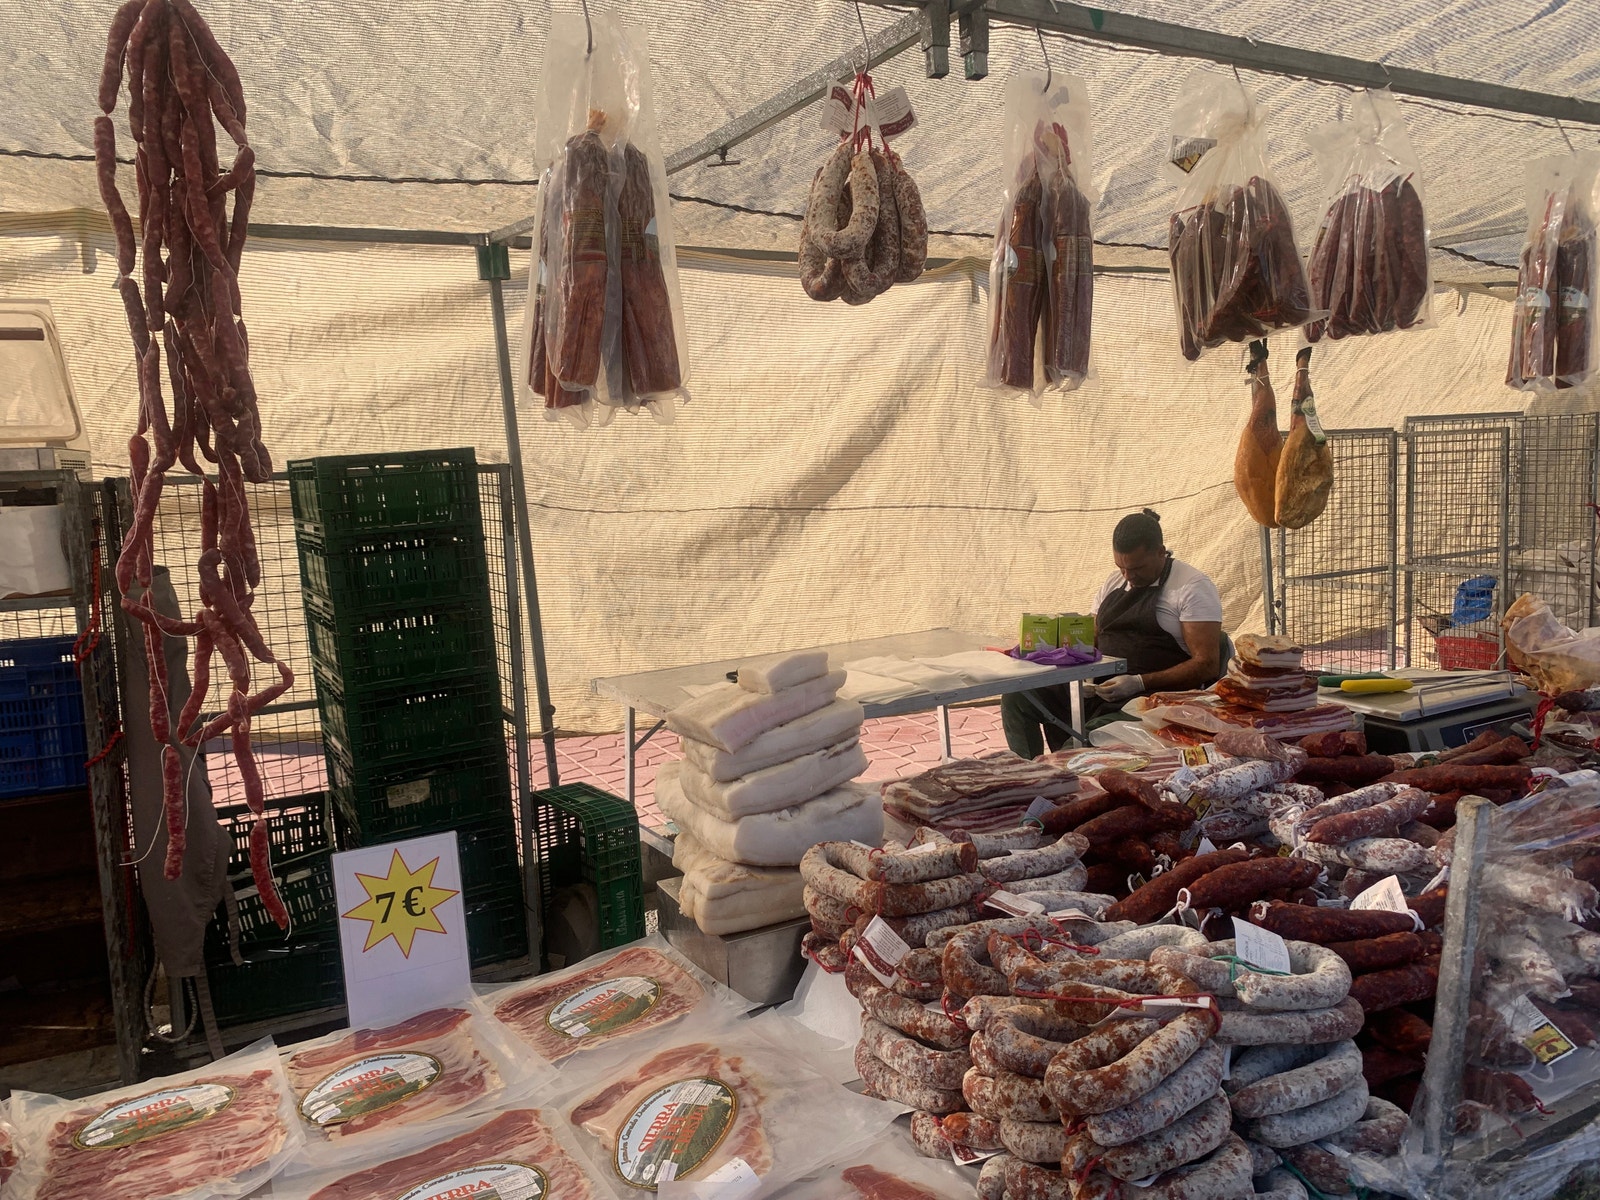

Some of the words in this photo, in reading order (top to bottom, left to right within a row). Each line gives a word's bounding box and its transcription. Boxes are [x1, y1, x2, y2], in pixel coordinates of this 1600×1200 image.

[375, 892, 396, 923] 7
[402, 886, 426, 917] €
[570, 988, 618, 1014] SIERRA
[331, 1066, 395, 1092] SIERRA
[116, 1095, 188, 1121] SIERRA
[638, 1102, 680, 1153] SIERRA
[424, 1180, 493, 1200] IERRA
